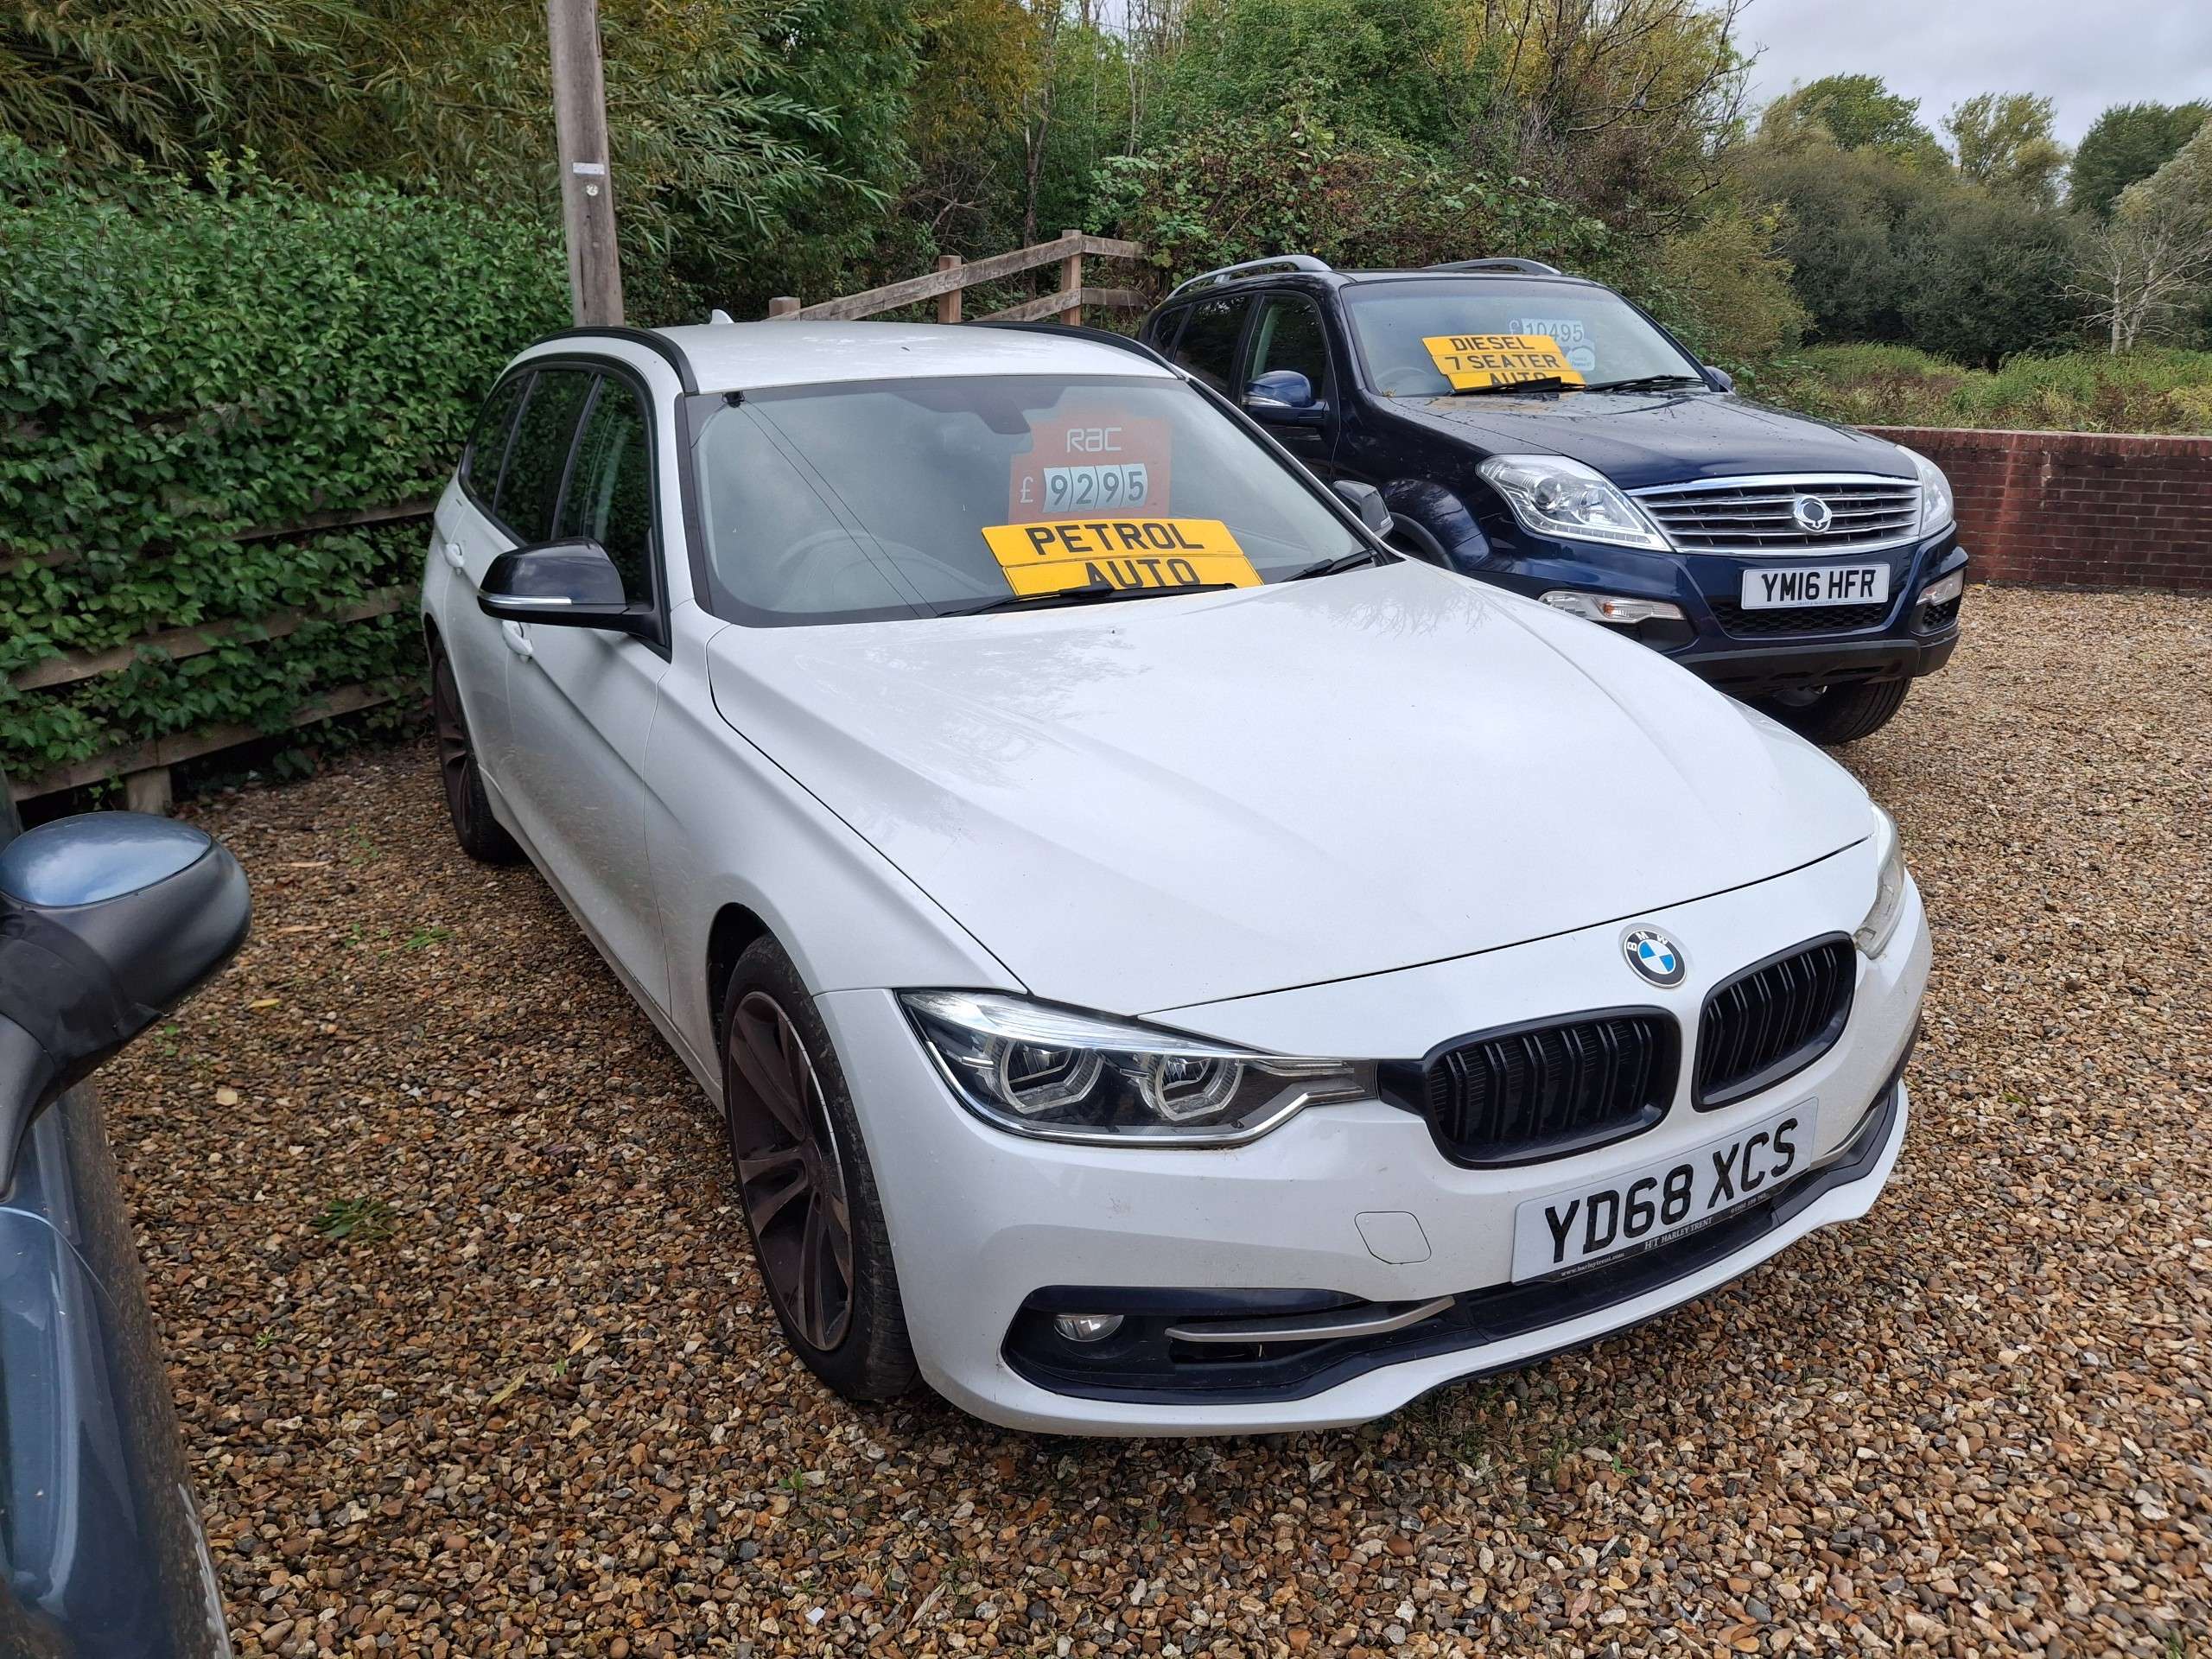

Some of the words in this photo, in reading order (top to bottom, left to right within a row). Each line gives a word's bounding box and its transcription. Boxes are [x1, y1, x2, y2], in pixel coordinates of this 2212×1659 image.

[1449, 336, 1535, 352] DIESEL
[1445, 357, 1460, 371] 7
[1467, 354, 1561, 369] SEATER
[1025, 523, 1205, 555] PETROL
[1085, 559, 1200, 588] AUTO
[1761, 571, 1821, 602] YM16
[1827, 569, 1877, 600] HFR
[1626, 931, 1669, 951] BMW
[1544, 1163, 1694, 1264] YD68
[1707, 1117, 1798, 1210] XCS
[1661, 1225, 1691, 1243] HARLEY
[1690, 1217, 1713, 1231] TRENT
